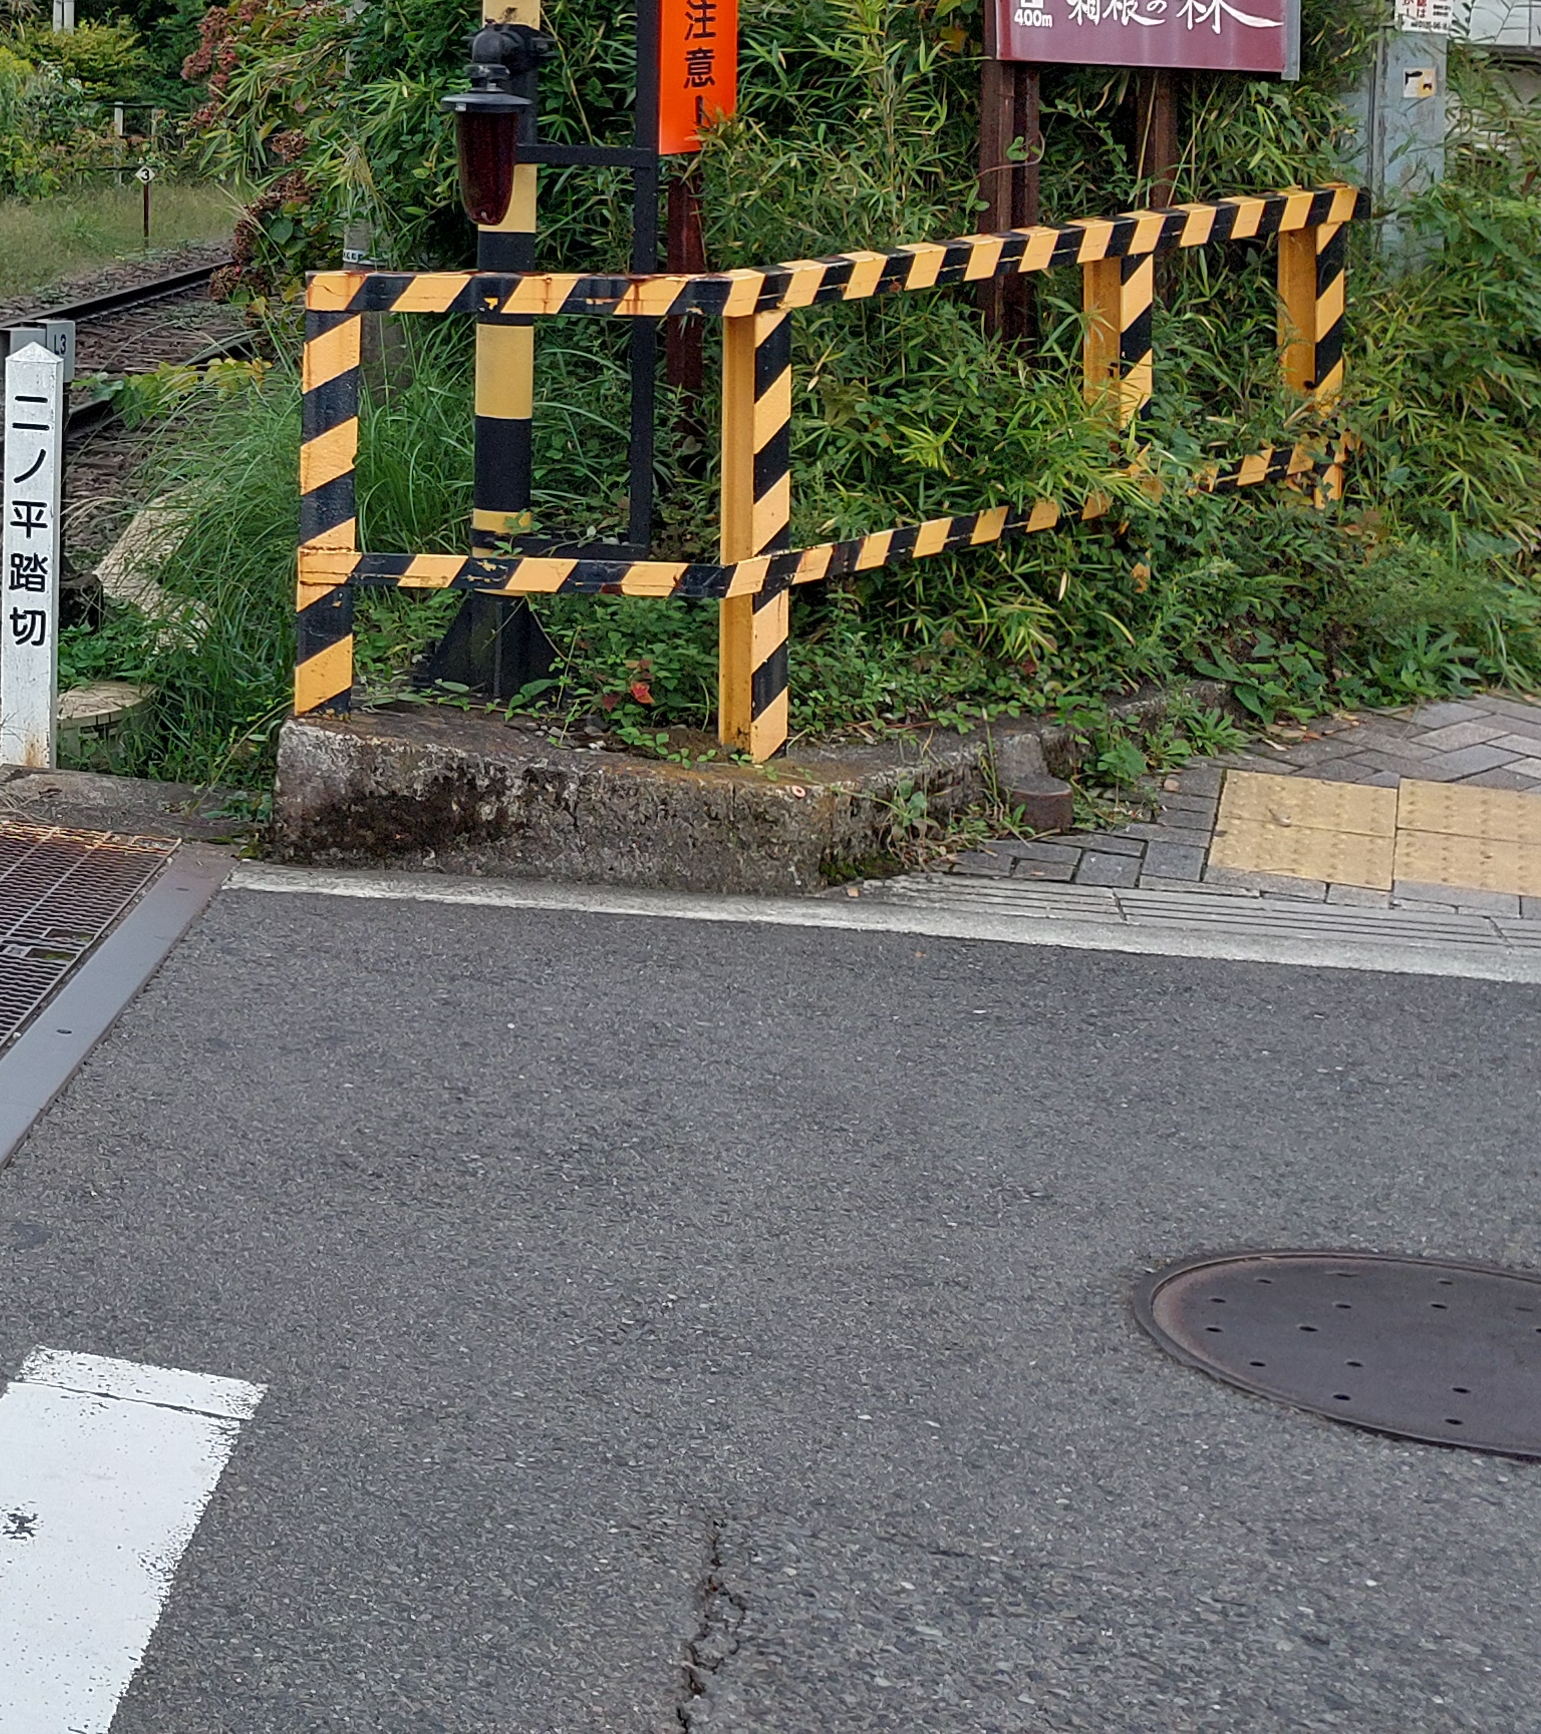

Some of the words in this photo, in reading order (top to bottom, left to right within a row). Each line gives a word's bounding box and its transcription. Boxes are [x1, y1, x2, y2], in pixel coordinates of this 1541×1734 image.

[1013, 8, 1053, 28] 400m
[141, 168, 150, 181] 3
[53, 334, 66, 355] L3
[8, 393, 50, 647] 二ノ平踏切
